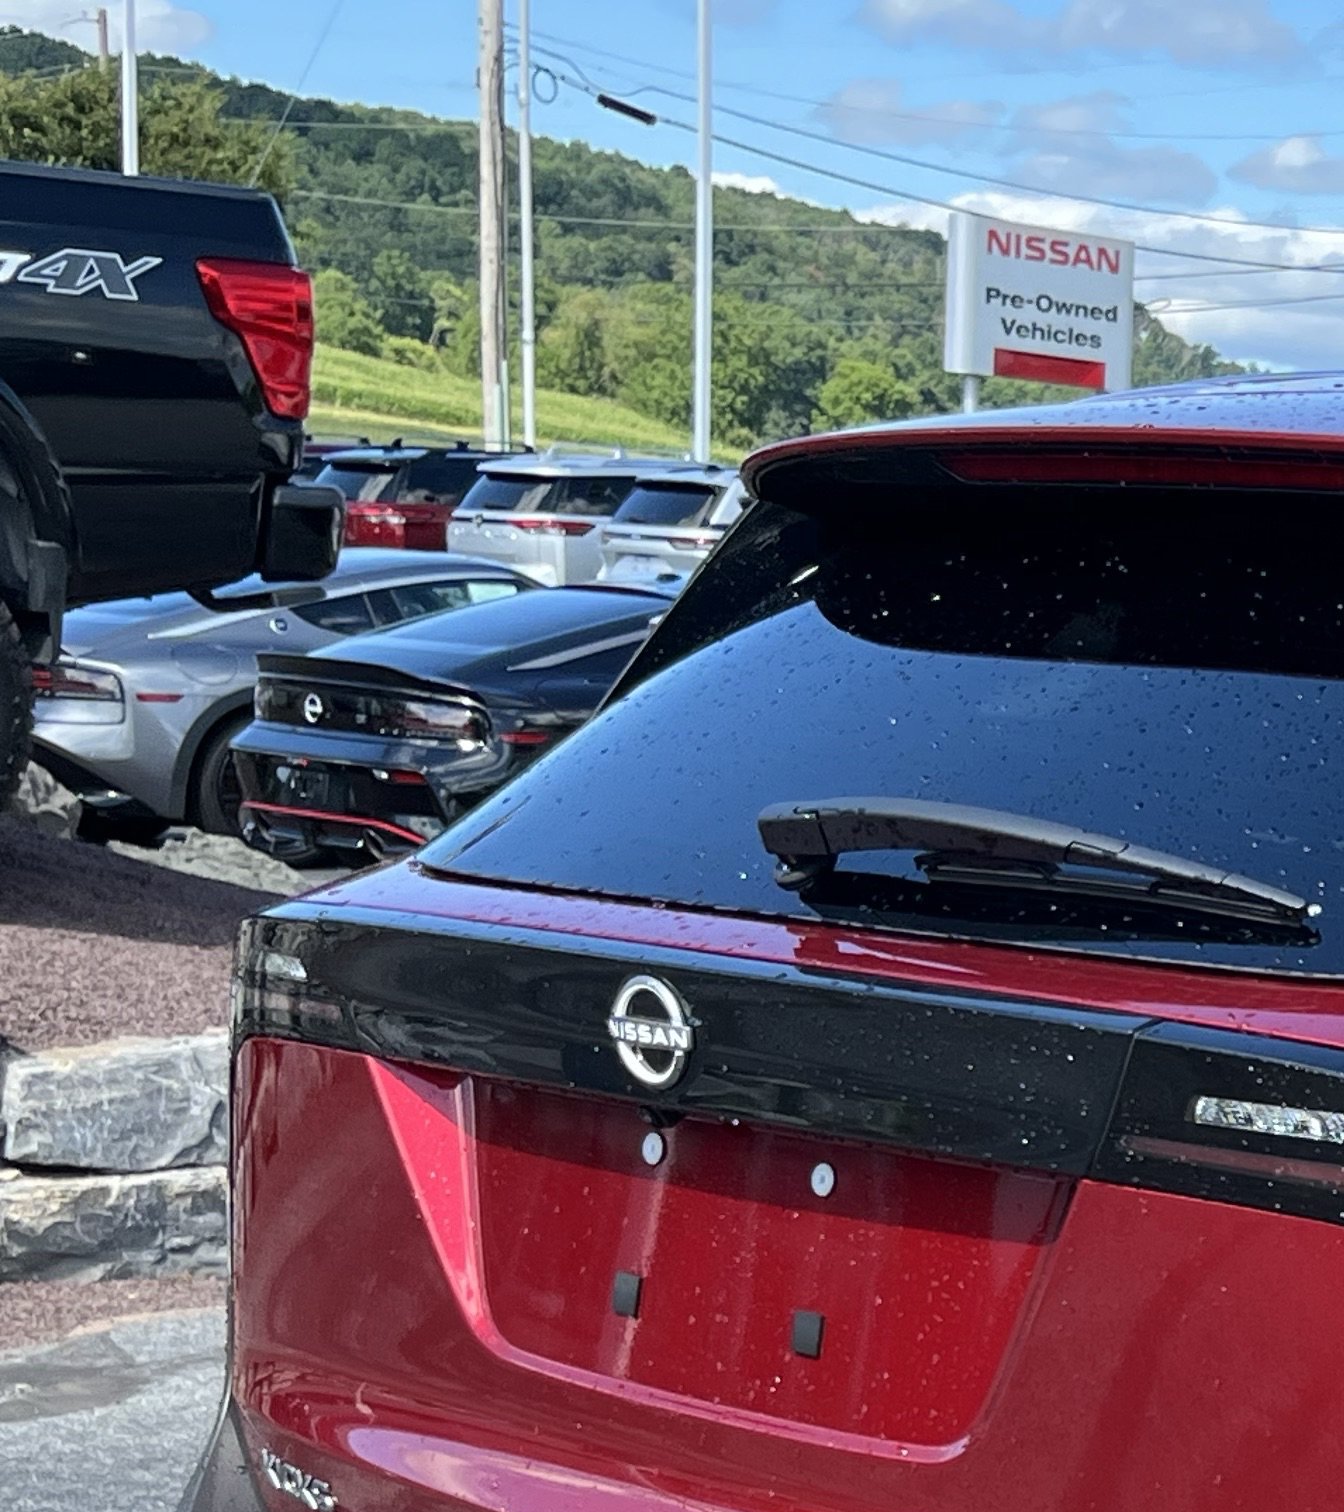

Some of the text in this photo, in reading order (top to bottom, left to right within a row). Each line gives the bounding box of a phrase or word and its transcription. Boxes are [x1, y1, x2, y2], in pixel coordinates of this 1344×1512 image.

[987, 228, 1120, 275] NISSAN
[986, 286, 1118, 323] Pre-Owned
[1001, 317, 1102, 349] Vehicles
[607, 1018, 688, 1048] NISSAN
